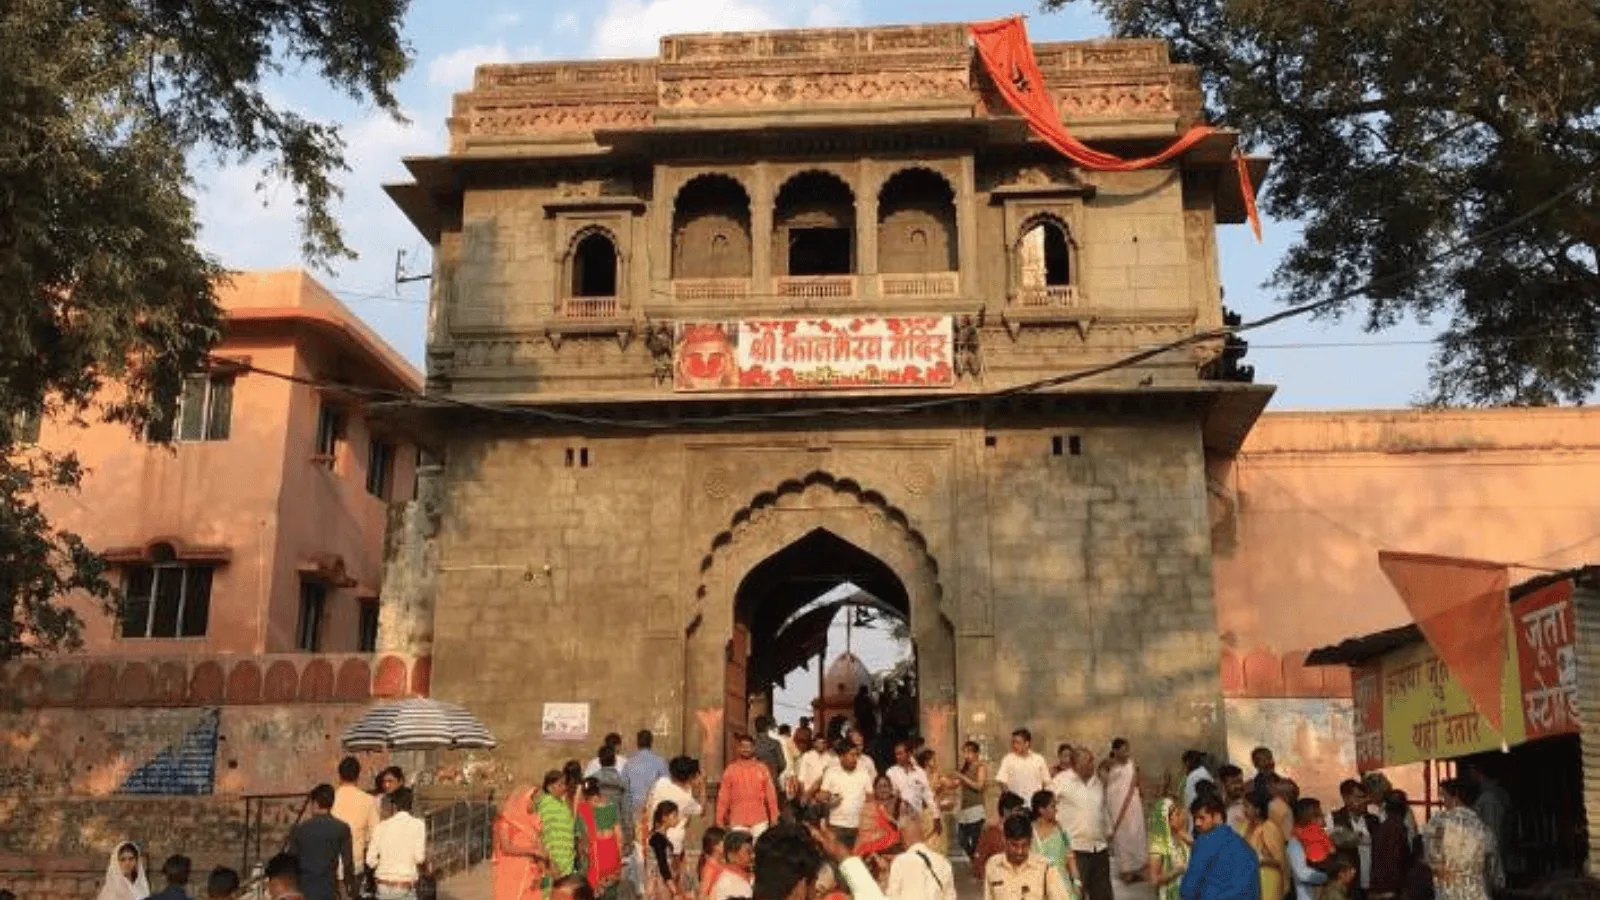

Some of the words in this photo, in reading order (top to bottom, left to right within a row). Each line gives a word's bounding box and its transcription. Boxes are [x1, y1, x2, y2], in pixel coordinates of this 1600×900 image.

[749, 329, 776, 363] श्री
[782, 327, 882, 362] कालभैरव
[889, 327, 947, 362] मंदिर
[1521, 601, 1568, 668] जूता
